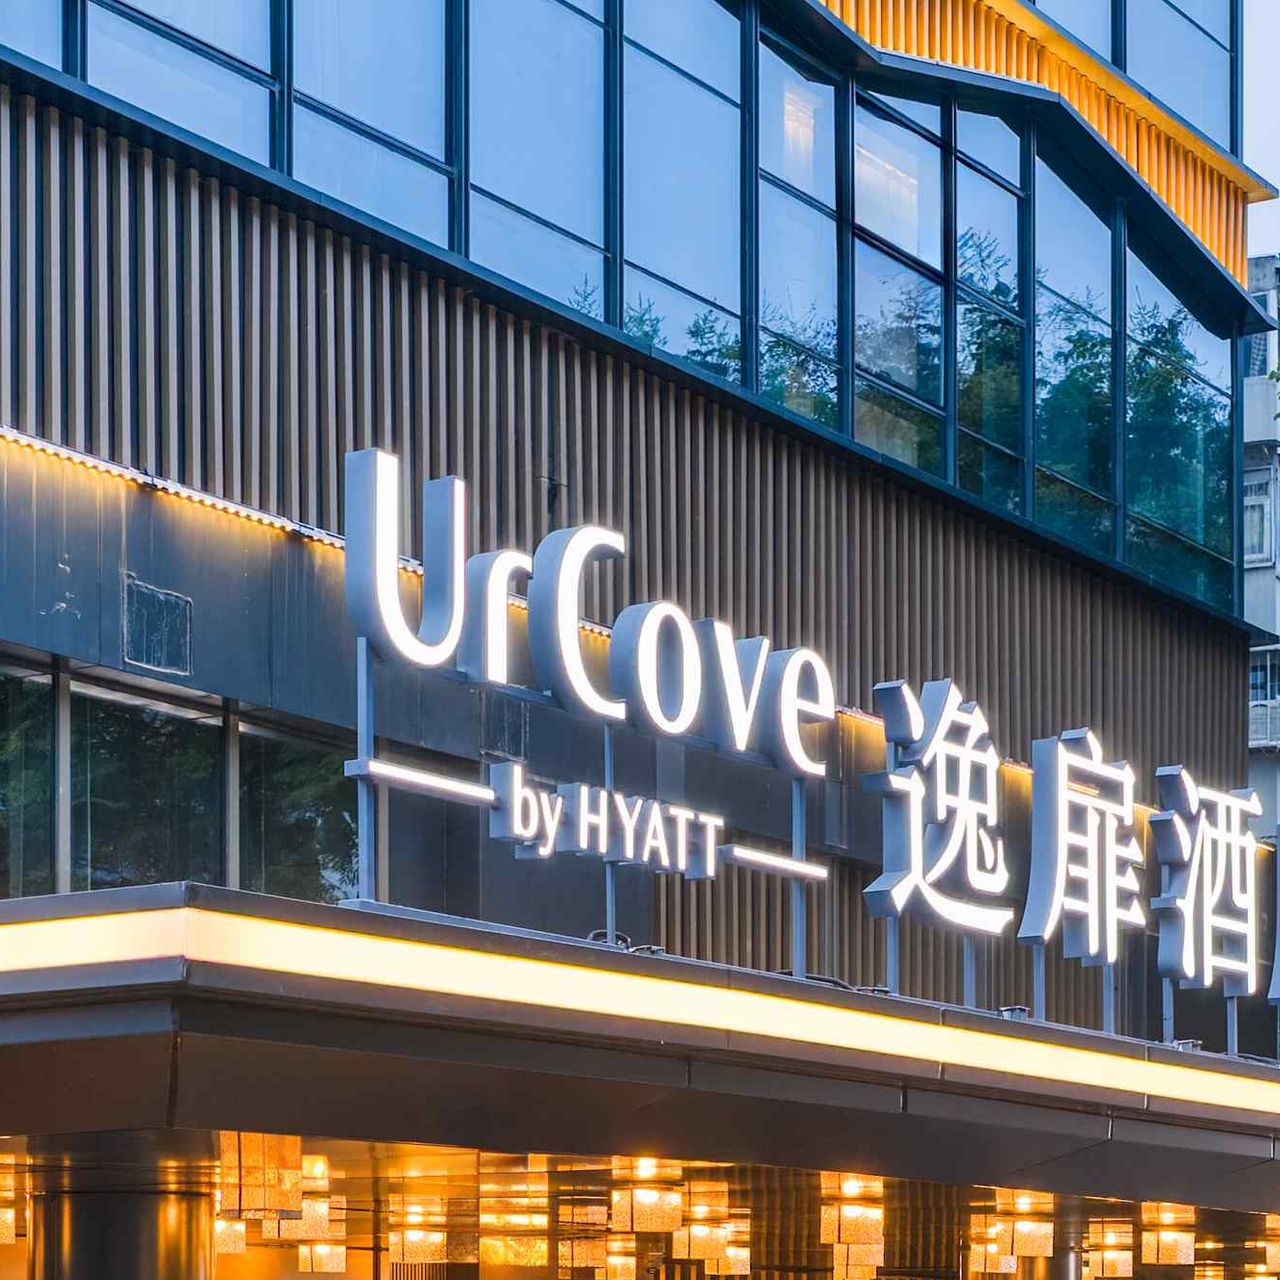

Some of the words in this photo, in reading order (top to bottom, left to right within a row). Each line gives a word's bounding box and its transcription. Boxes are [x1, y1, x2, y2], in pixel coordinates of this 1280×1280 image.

[370, 448, 838, 777] UrCove
[511, 763, 563, 858] by
[577, 786, 725, 877] HYATT
